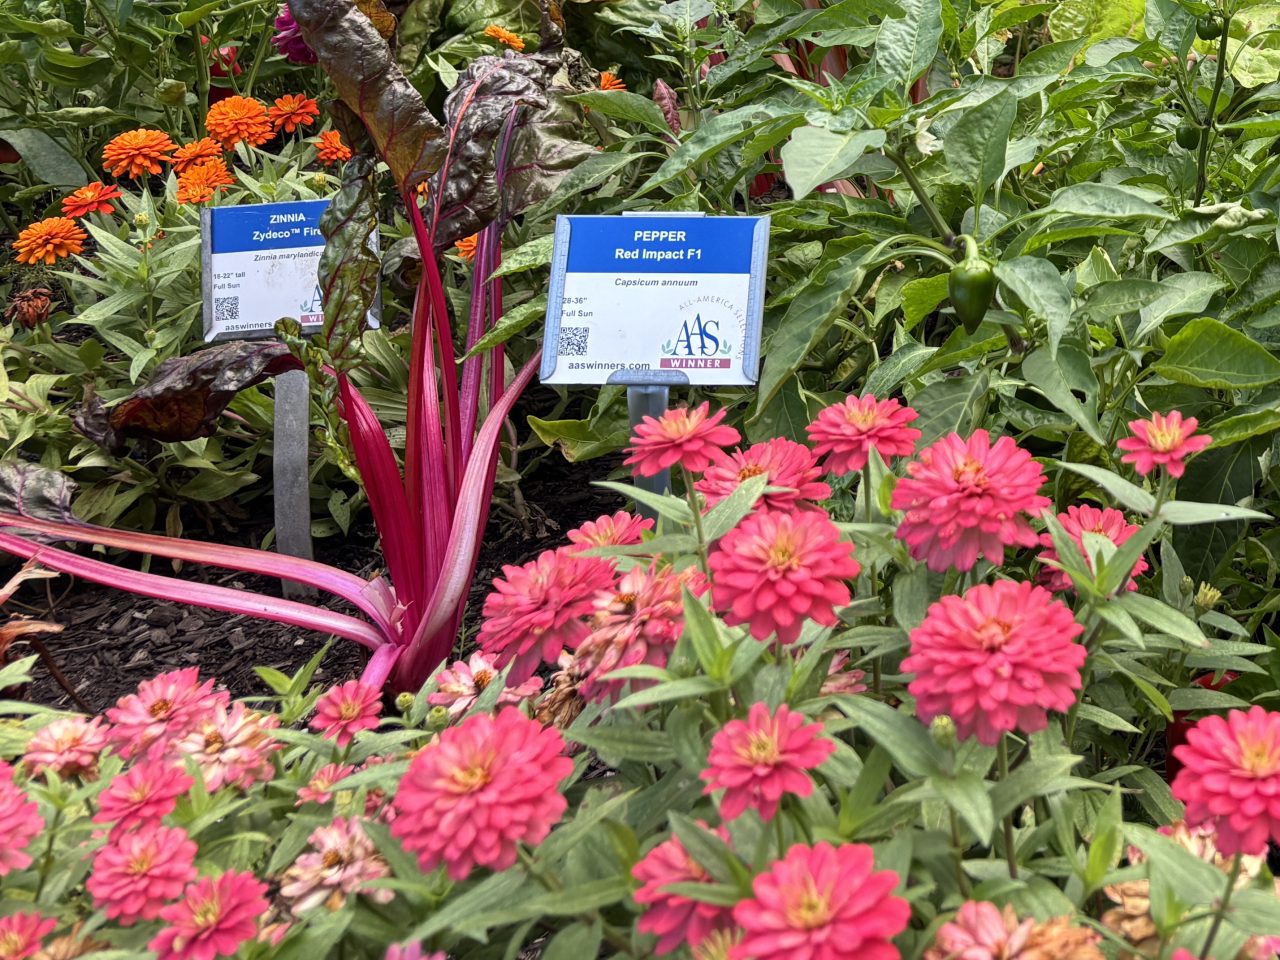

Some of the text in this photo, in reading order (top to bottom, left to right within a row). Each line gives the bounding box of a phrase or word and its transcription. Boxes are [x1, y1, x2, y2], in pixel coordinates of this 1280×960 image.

[270, 213, 306, 224] ZINNIA
[634, 230, 686, 242] PEPPER
[254, 254, 277, 262] Zinnia
[615, 249, 702, 261] Red Impact F1
[614, 278, 698, 287] Capsicum annuum
[561, 309, 576, 317] Full
[225, 322, 273, 331] aaswinners
[670, 313, 719, 356] AAS
[568, 361, 650, 370] aaswinners.com
[670, 359, 721, 368] WINNER
